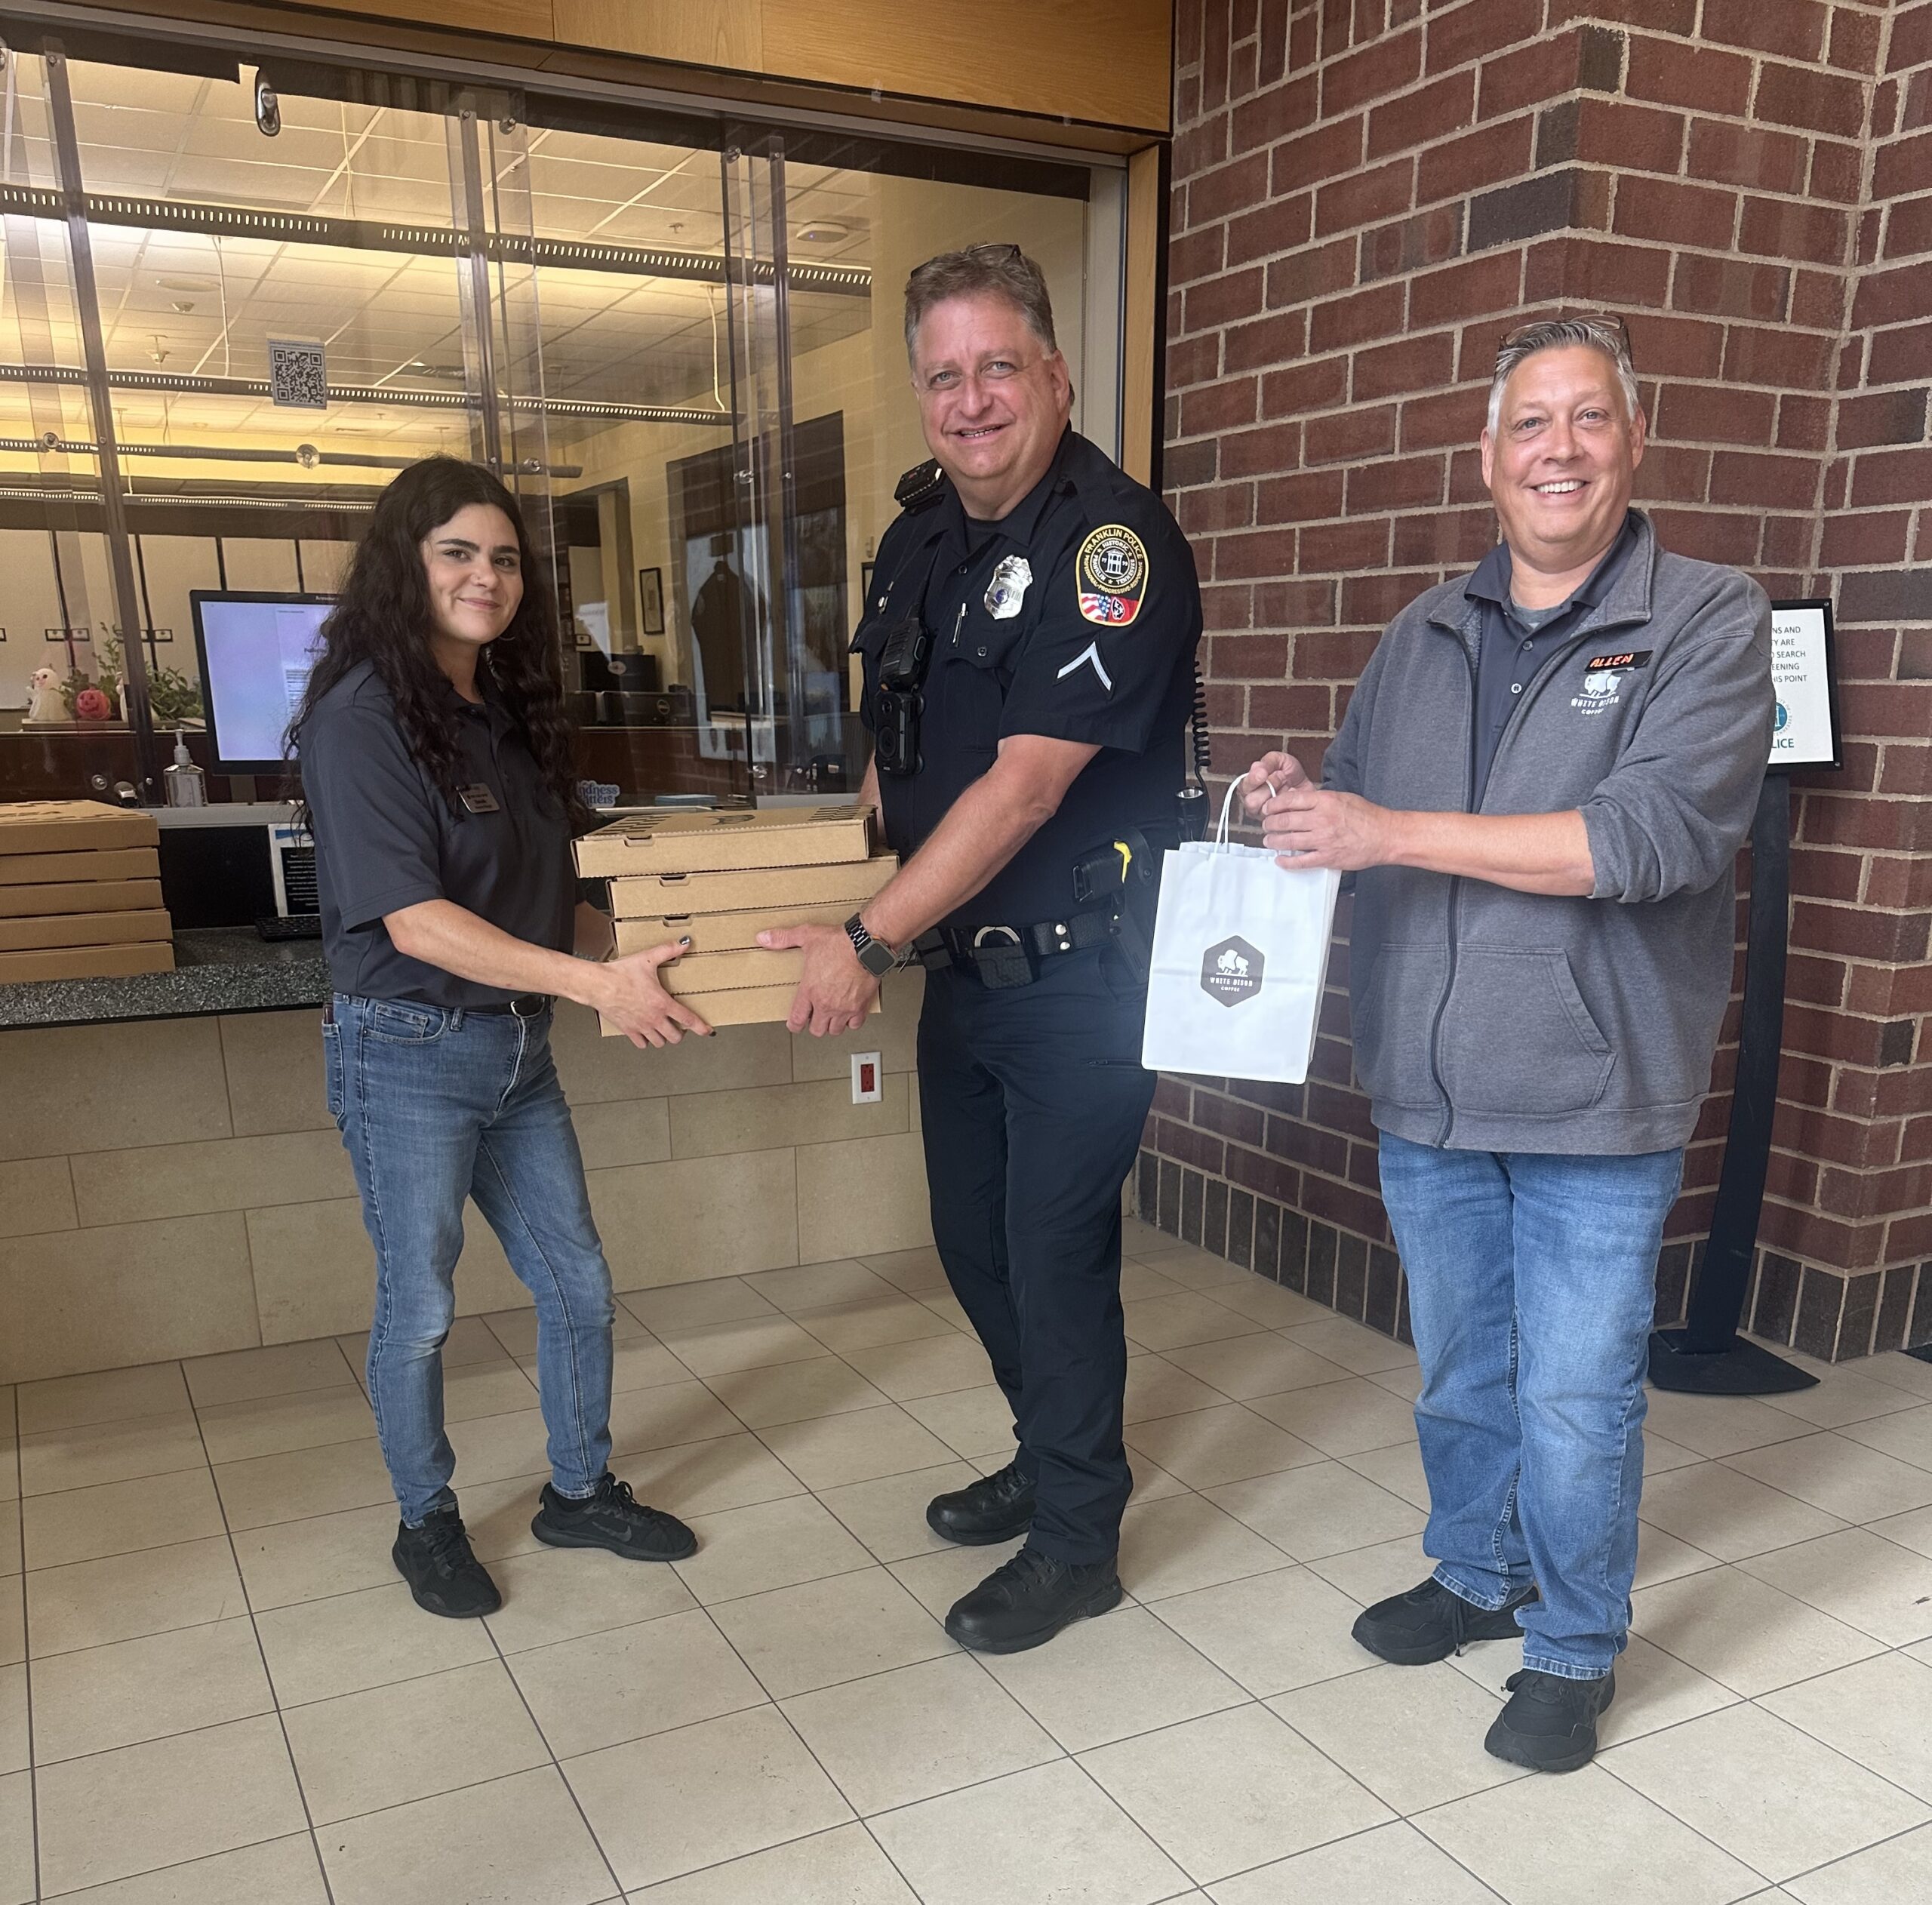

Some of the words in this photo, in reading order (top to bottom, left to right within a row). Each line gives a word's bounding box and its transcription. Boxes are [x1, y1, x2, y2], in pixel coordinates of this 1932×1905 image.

[1084, 529, 1122, 553] FRANKLIN
[1123, 533, 1143, 559] POLICE
[1102, 540, 1129, 551] HISTORIC
[1092, 554, 1106, 581] FRANKLIN
[1784, 626, 1801, 634] AND
[1777, 650, 1806, 658] SEARCH
[1589, 654, 1634, 668] ALLEN
[1784, 674, 1807, 683] POINT
[1571, 697, 1597, 708] WHITE
[1210, 977, 1231, 985] WHITE
